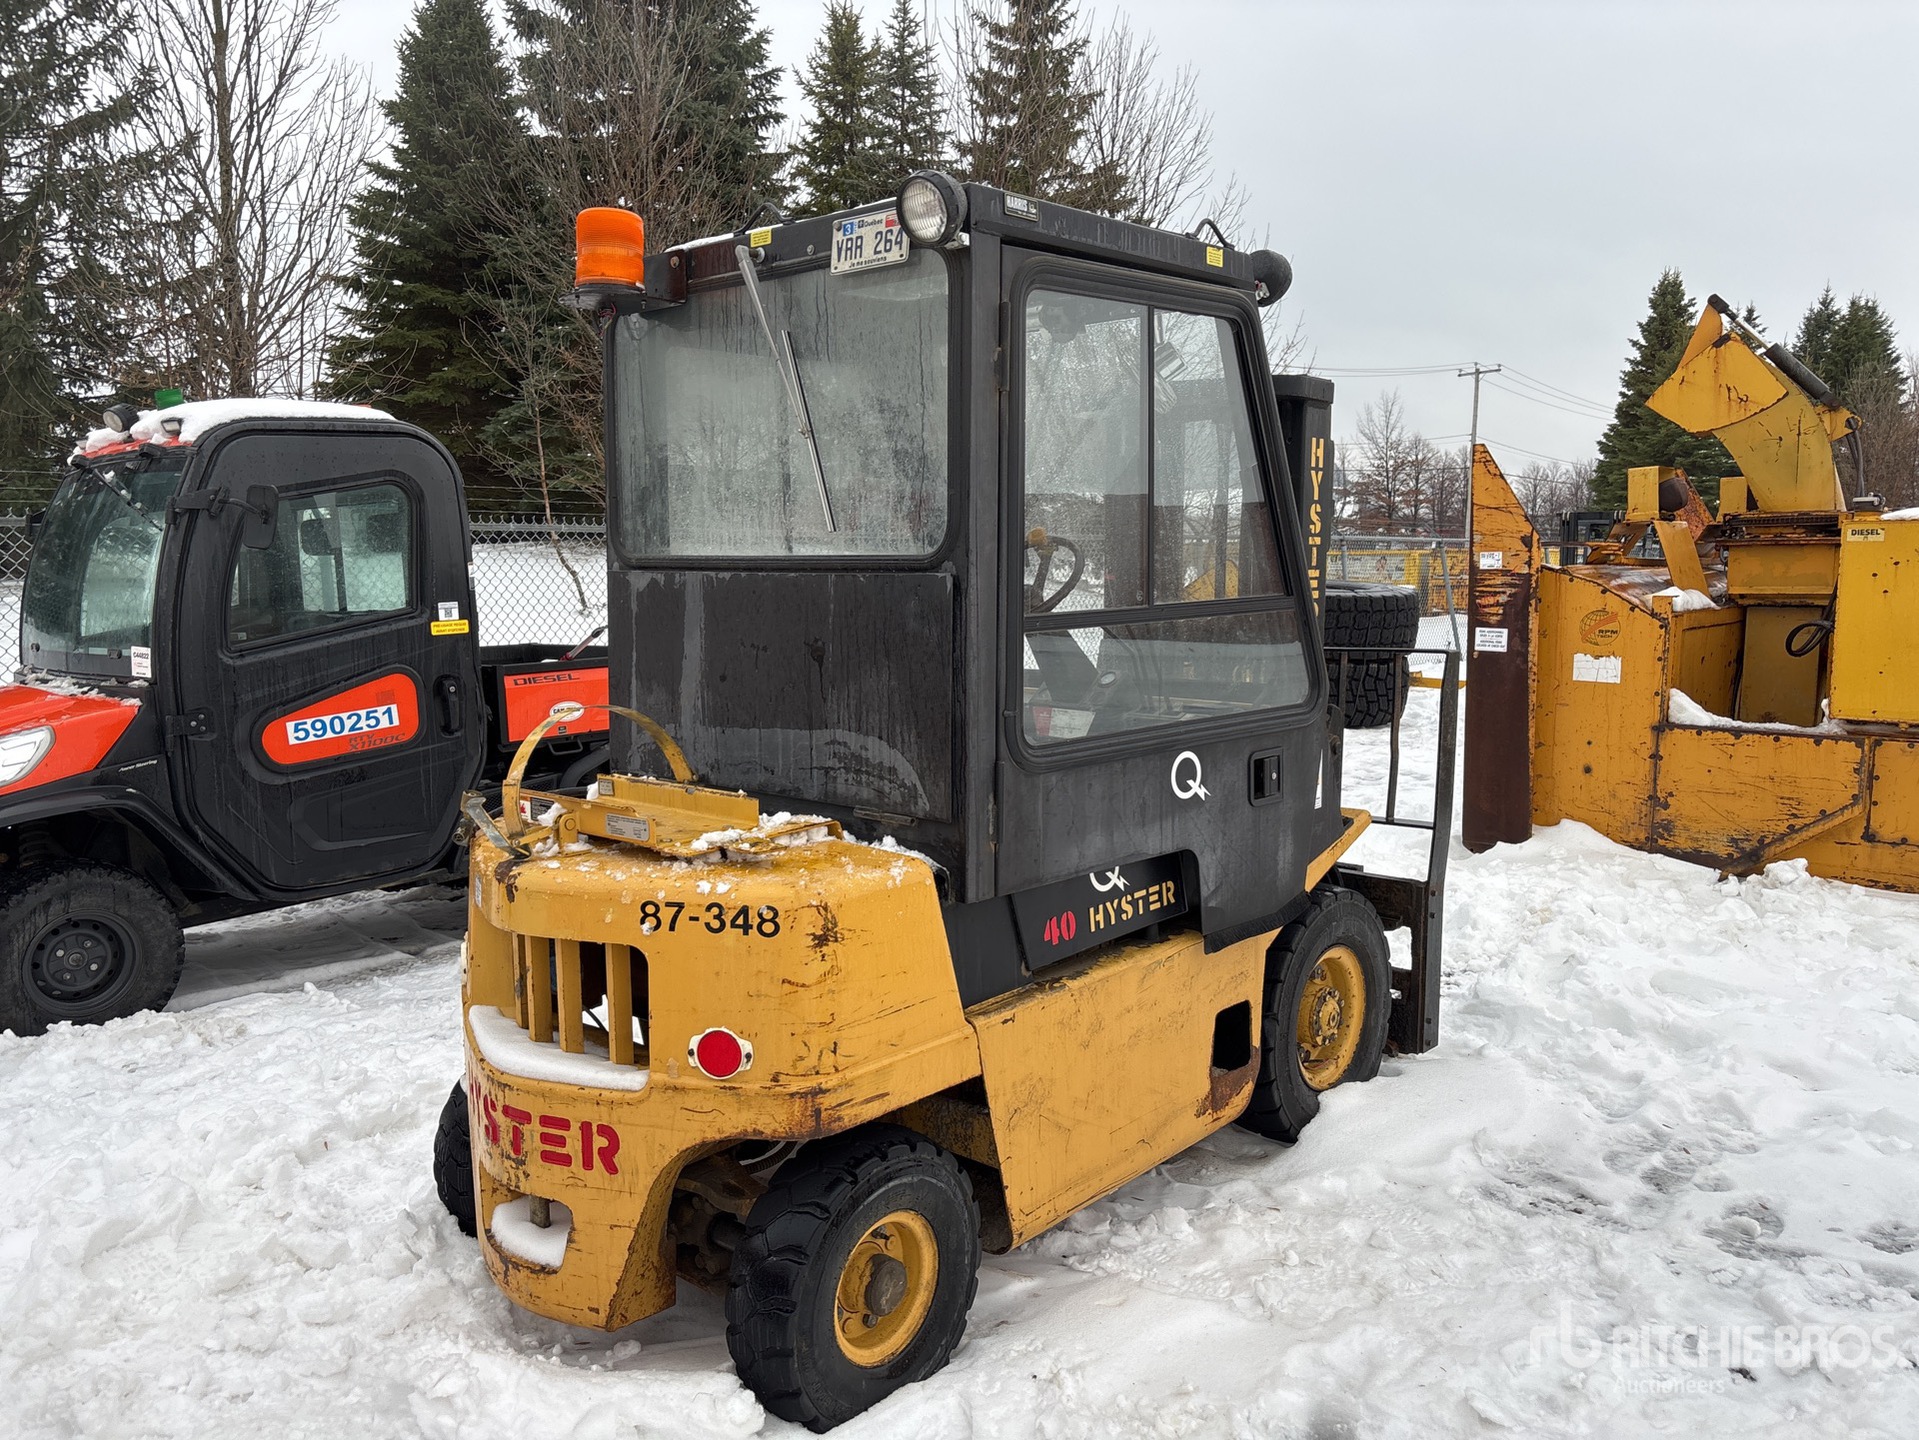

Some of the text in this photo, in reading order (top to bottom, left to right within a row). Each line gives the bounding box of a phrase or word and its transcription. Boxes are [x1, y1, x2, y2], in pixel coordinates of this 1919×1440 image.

[845, 224, 851, 235] 3
[873, 228, 905, 255] 264
[1851, 528, 1881, 536] DIESEL
[513, 673, 580, 686] DIESEL
[293, 706, 395, 742] 590251
[349, 733, 375, 744] RTV
[639, 900, 781, 938] 87-348
[1043, 880, 1176, 946] 40 HYSTER
